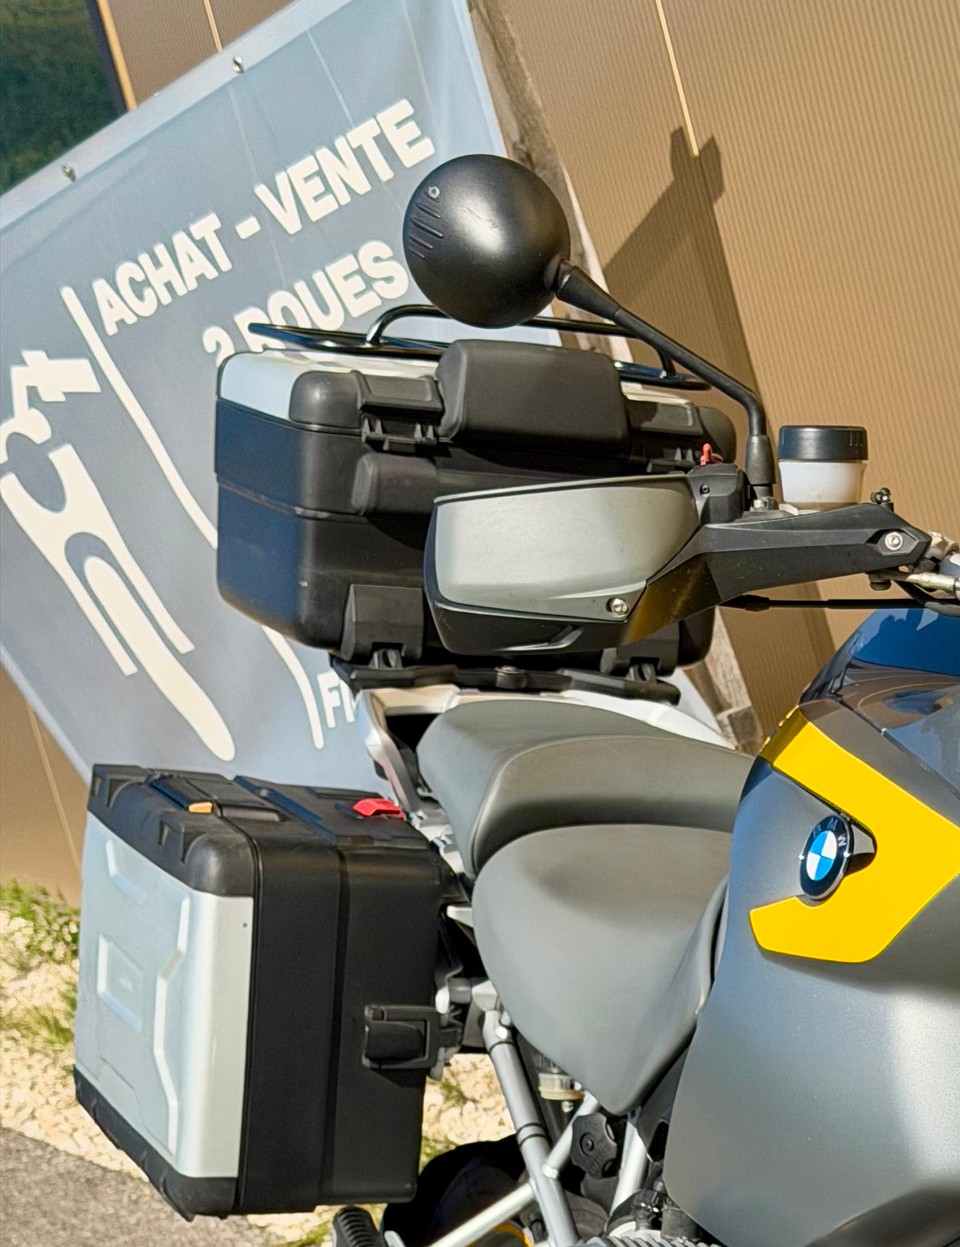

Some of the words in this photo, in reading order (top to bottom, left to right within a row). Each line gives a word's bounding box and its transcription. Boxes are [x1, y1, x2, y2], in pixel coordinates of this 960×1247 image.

[91, 211, 233, 337] ACHAT
[234, 215, 262, 240] -
[253, 98, 435, 235] VENTE
[233, 240, 410, 354] ROUES
